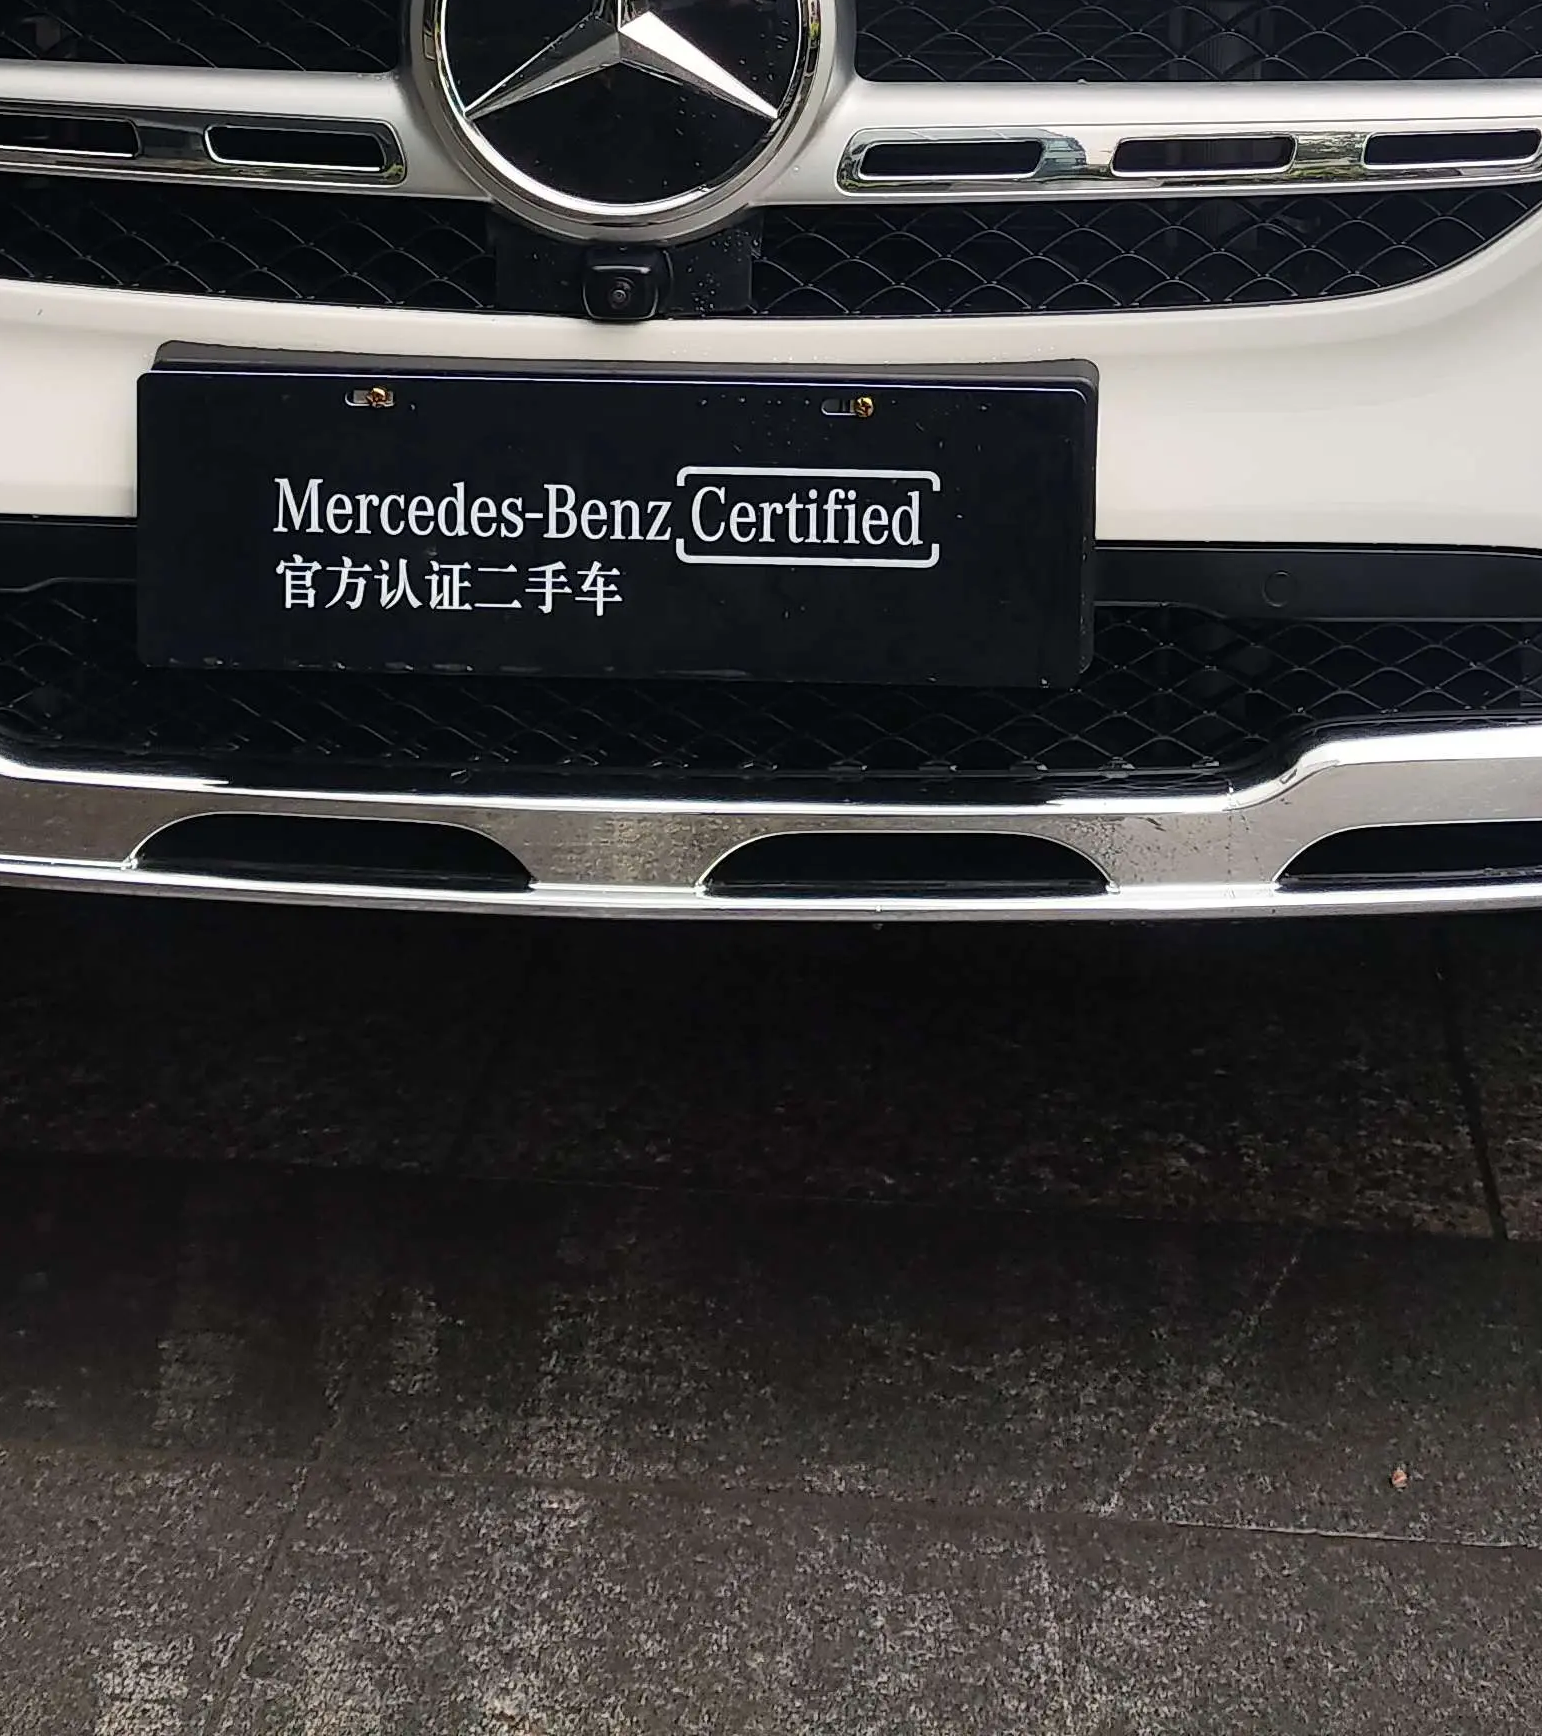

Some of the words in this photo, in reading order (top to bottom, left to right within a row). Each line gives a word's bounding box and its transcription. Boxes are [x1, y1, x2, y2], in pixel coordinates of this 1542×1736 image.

[272, 477, 672, 543] Mercedes-Benz
[691, 485, 923, 548] Certified
[274, 555, 624, 618] 官方认证二手车
